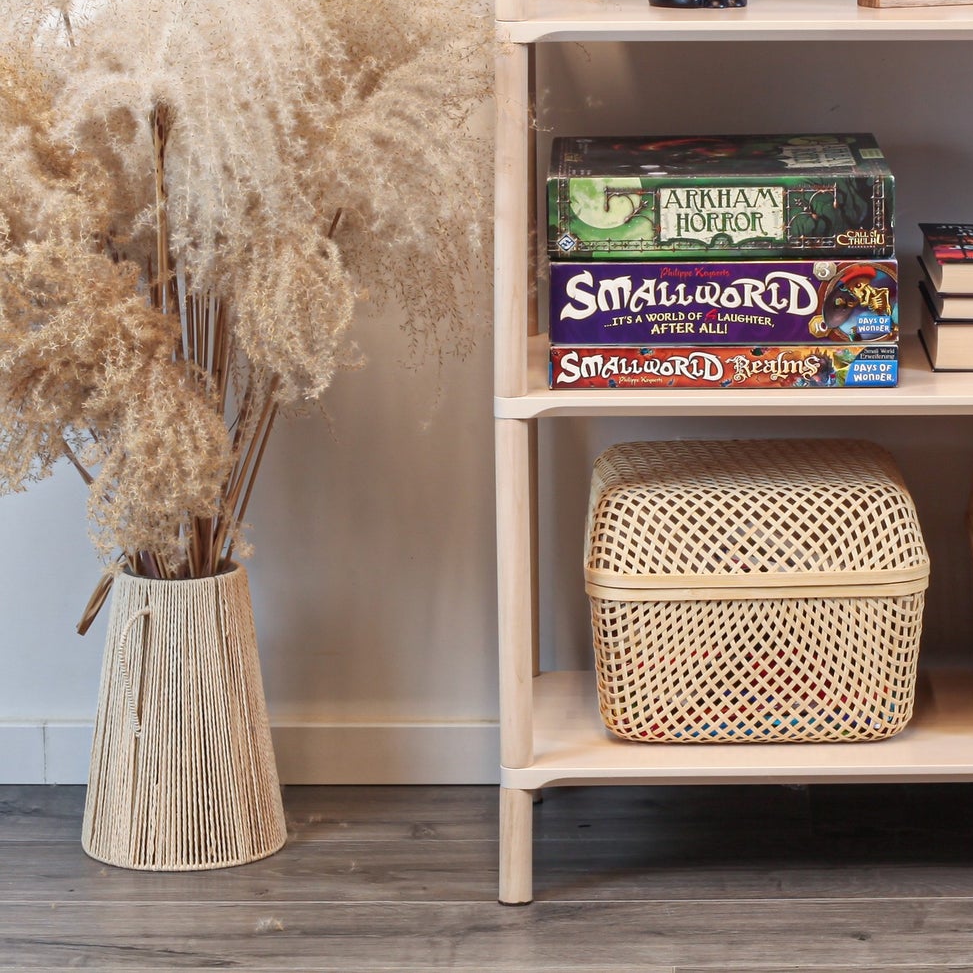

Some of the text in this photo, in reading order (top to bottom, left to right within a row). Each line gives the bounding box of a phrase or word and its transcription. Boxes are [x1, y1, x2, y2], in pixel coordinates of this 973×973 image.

[662, 188, 779, 211] ARKHAM
[676, 210, 768, 236] HORROR
[837, 234, 885, 245] CTHULHU
[818, 263, 829, 278] 3
[635, 315, 642, 323] A
[646, 311, 685, 322] WORLD
[688, 312, 703, 320] OF
[651, 323, 728, 335] AFTER ALL!
[725, 351, 820, 383] Realms
[854, 363, 892, 372] DAYS OF
[853, 373, 893, 382] WONDER
